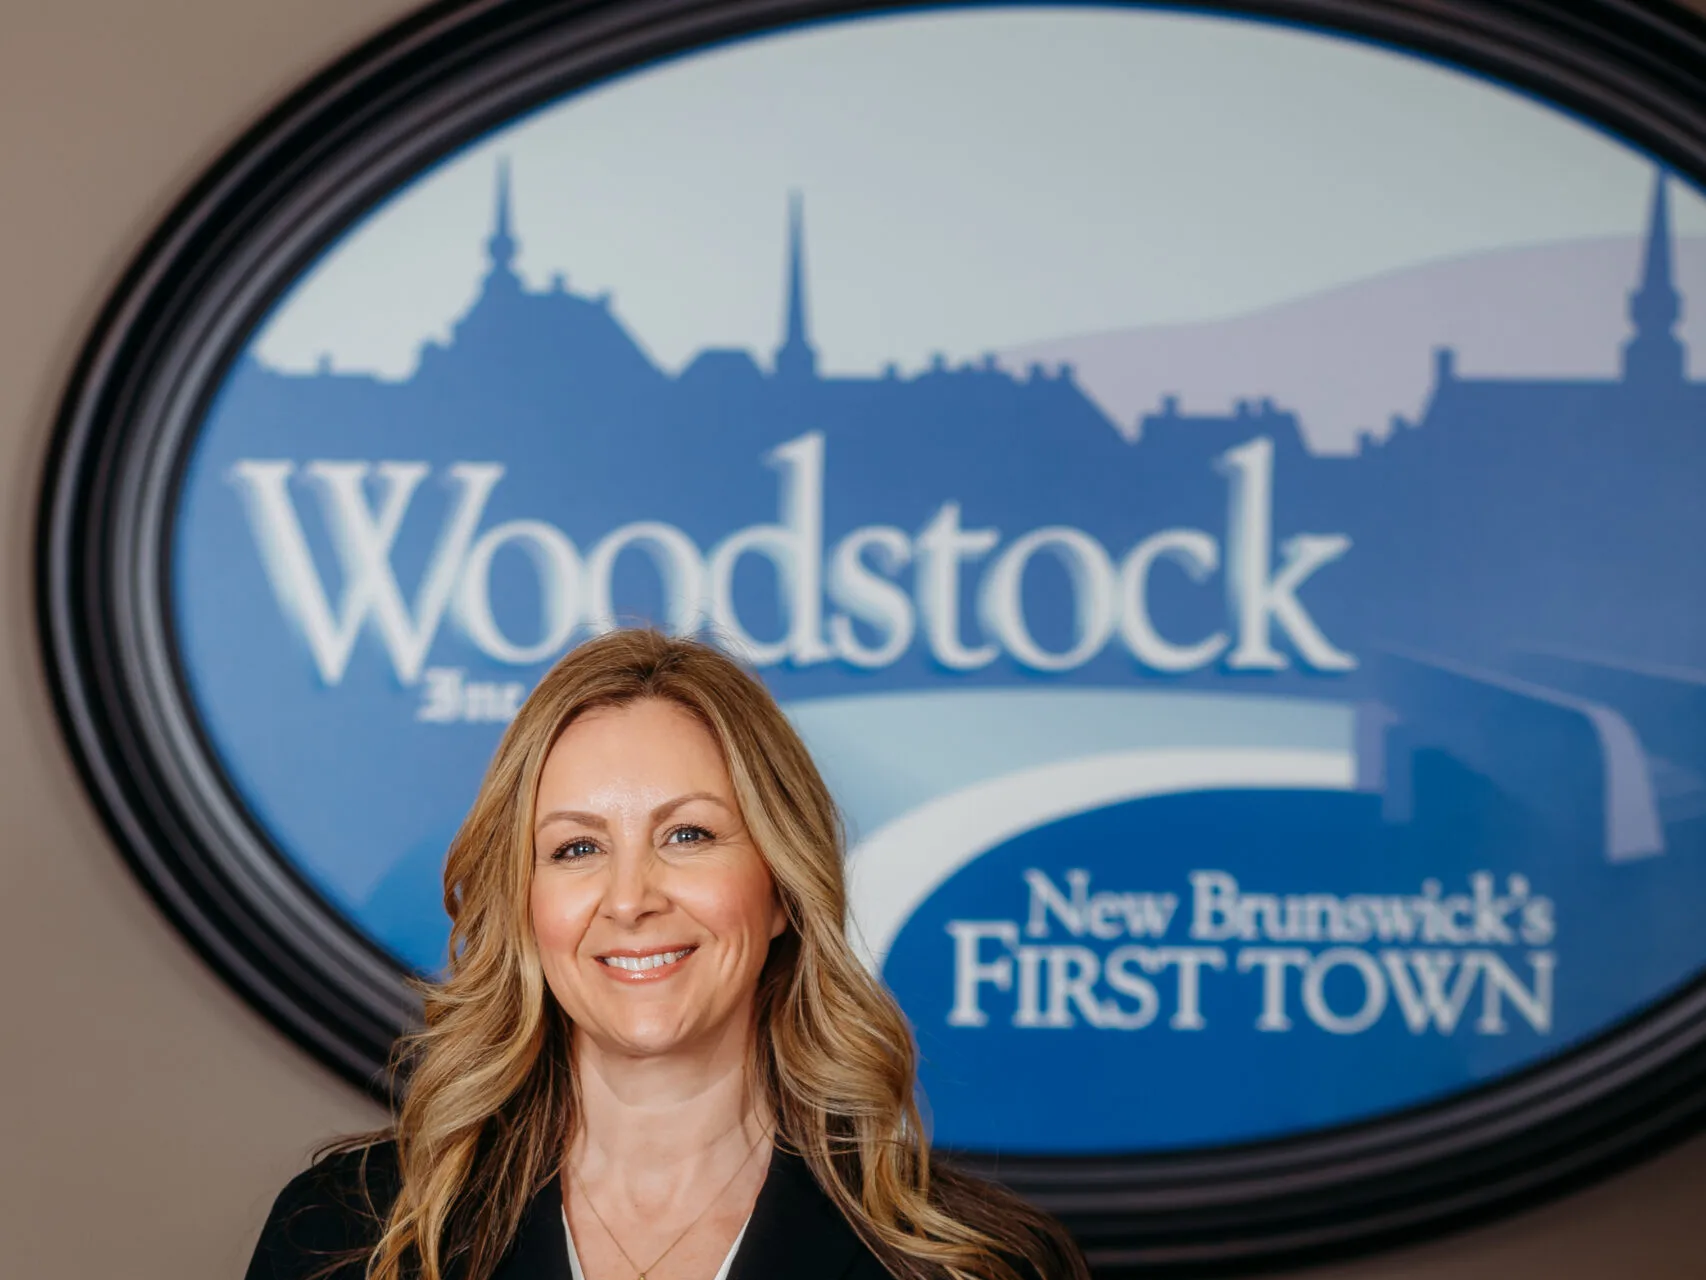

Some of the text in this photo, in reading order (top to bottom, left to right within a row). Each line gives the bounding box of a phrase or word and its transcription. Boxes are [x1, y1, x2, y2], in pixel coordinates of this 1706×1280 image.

[230, 430, 1356, 686] Woodstock
[1024, 868, 1556, 946] New Brunswick's
[945, 921, 1557, 1034] FIRST TOWN
